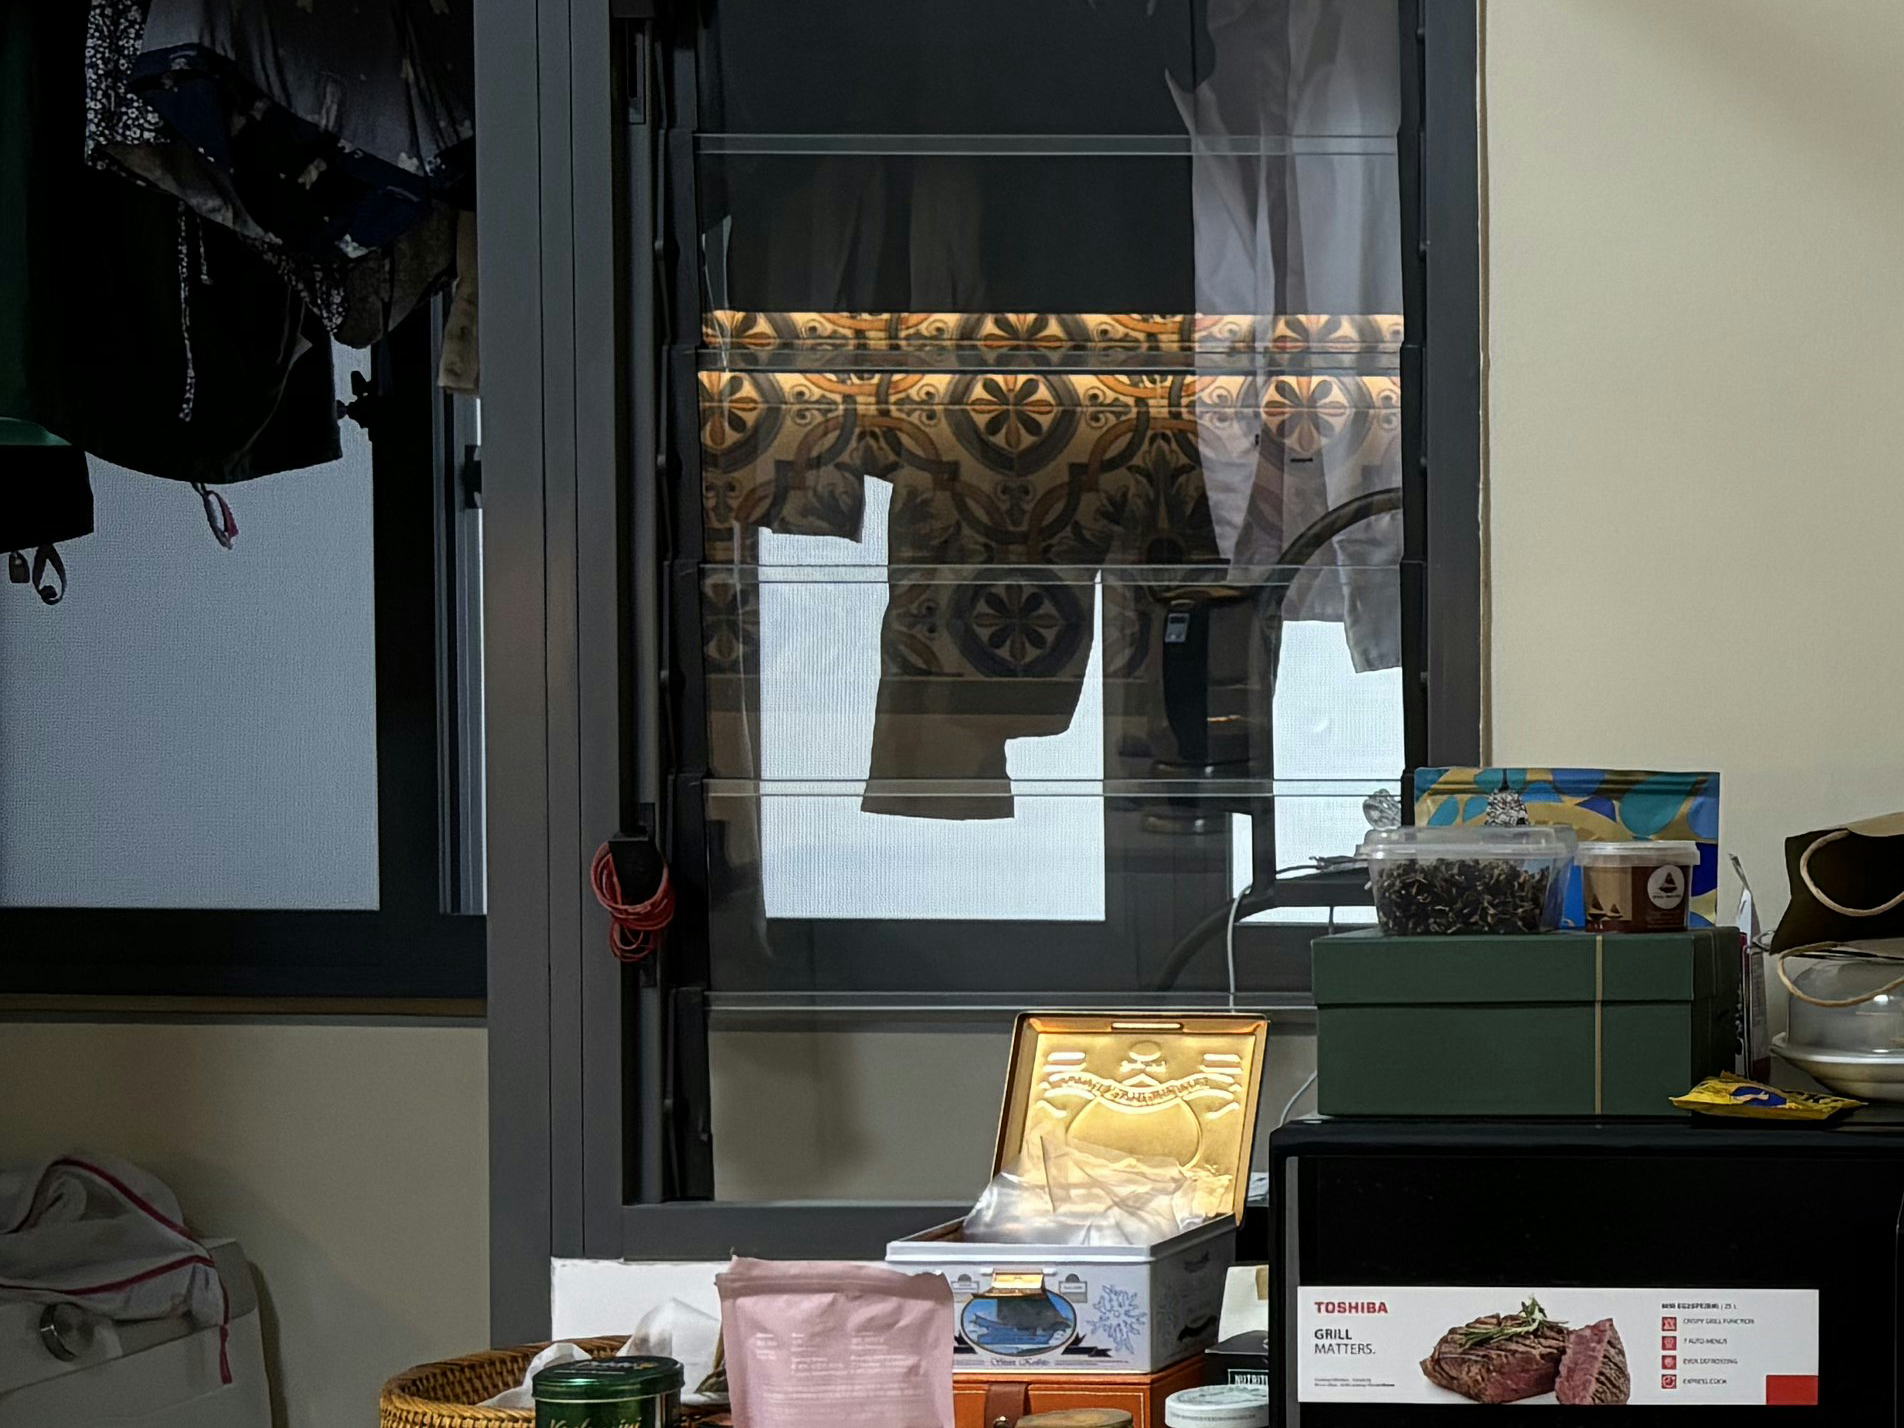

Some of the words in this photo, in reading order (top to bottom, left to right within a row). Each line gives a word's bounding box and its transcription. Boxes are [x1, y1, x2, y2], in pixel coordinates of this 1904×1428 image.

[1314, 1301, 1388, 1314] TOSHIBA
[1314, 1328, 1353, 1340] GRILL
[1314, 1343, 1376, 1355] MATTERS.
